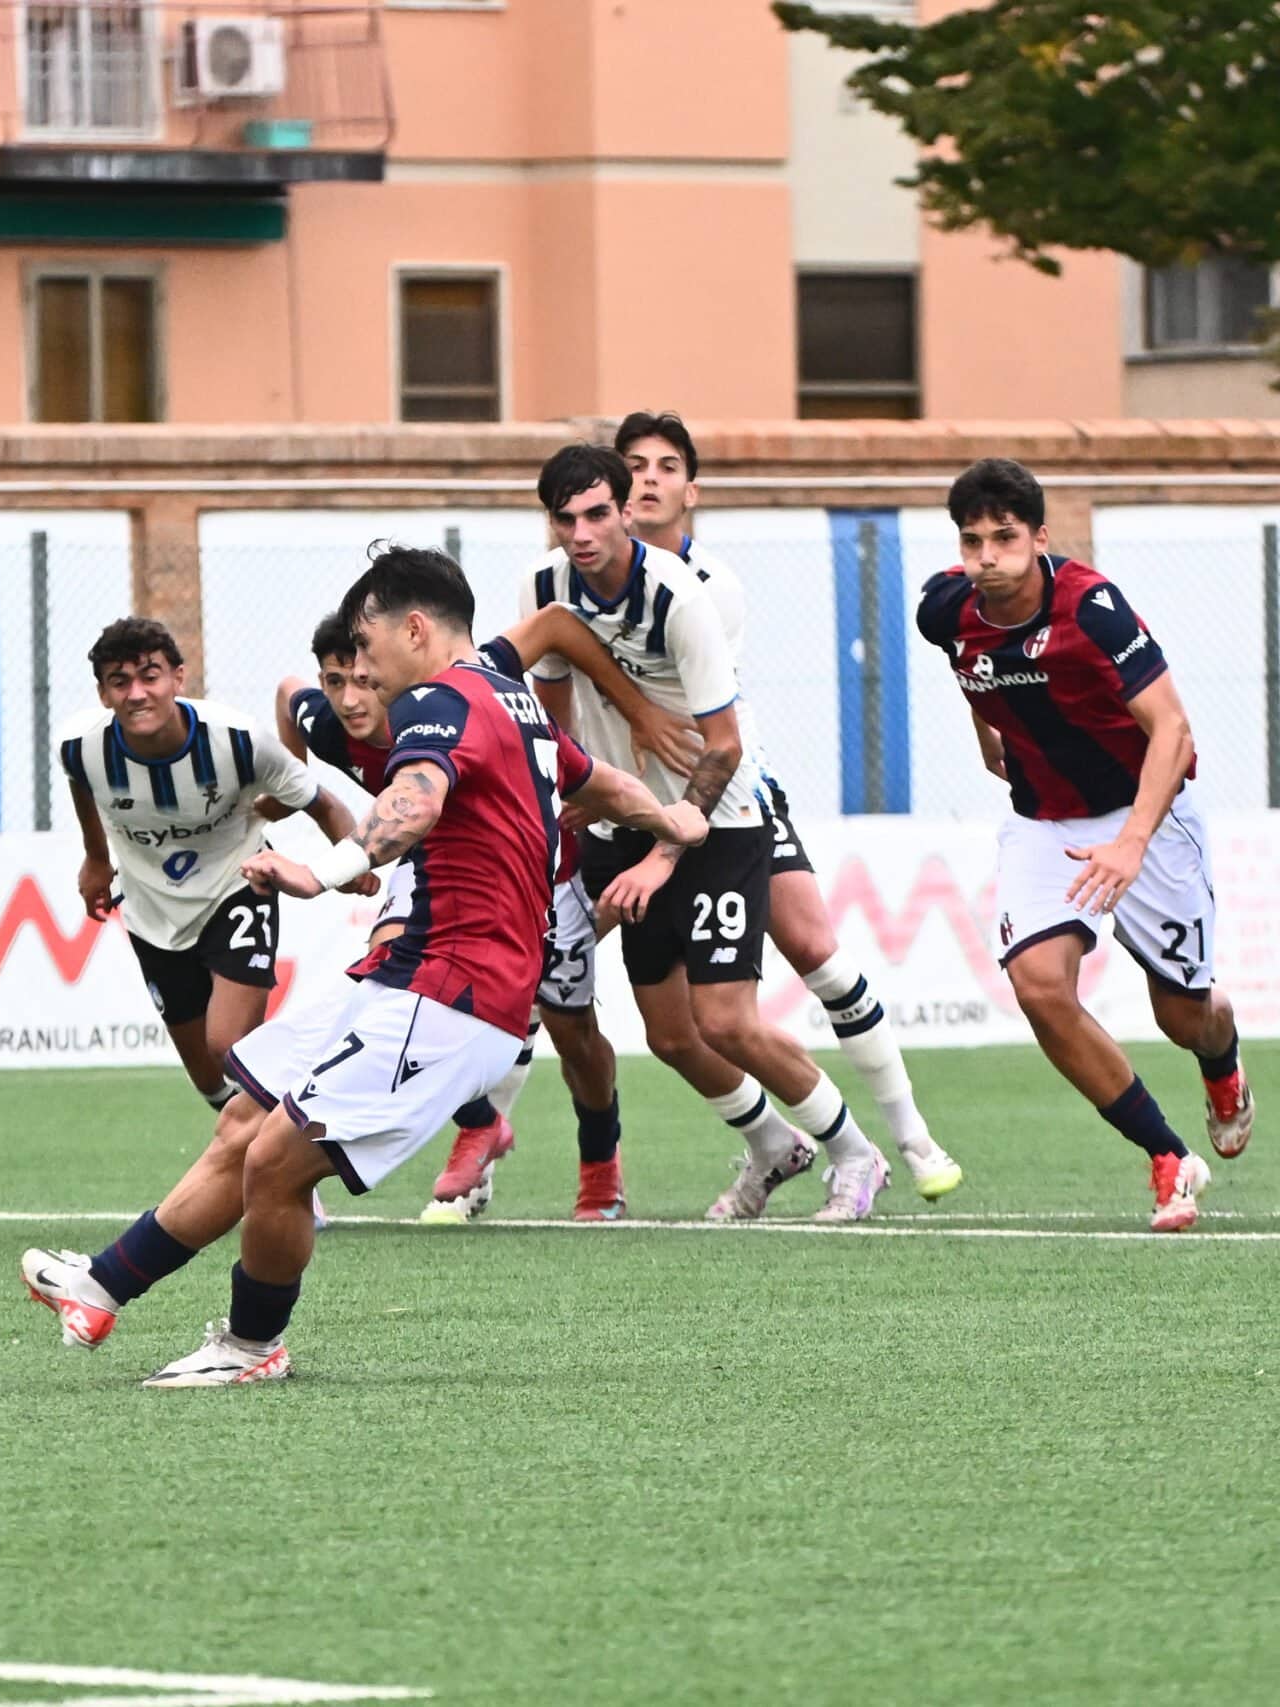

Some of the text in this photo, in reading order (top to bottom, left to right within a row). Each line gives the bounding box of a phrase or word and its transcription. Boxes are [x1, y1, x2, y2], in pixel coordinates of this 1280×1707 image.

[691, 891, 746, 941] 29
[1160, 918, 1204, 963] 21
[312, 1031, 364, 1076] 7
